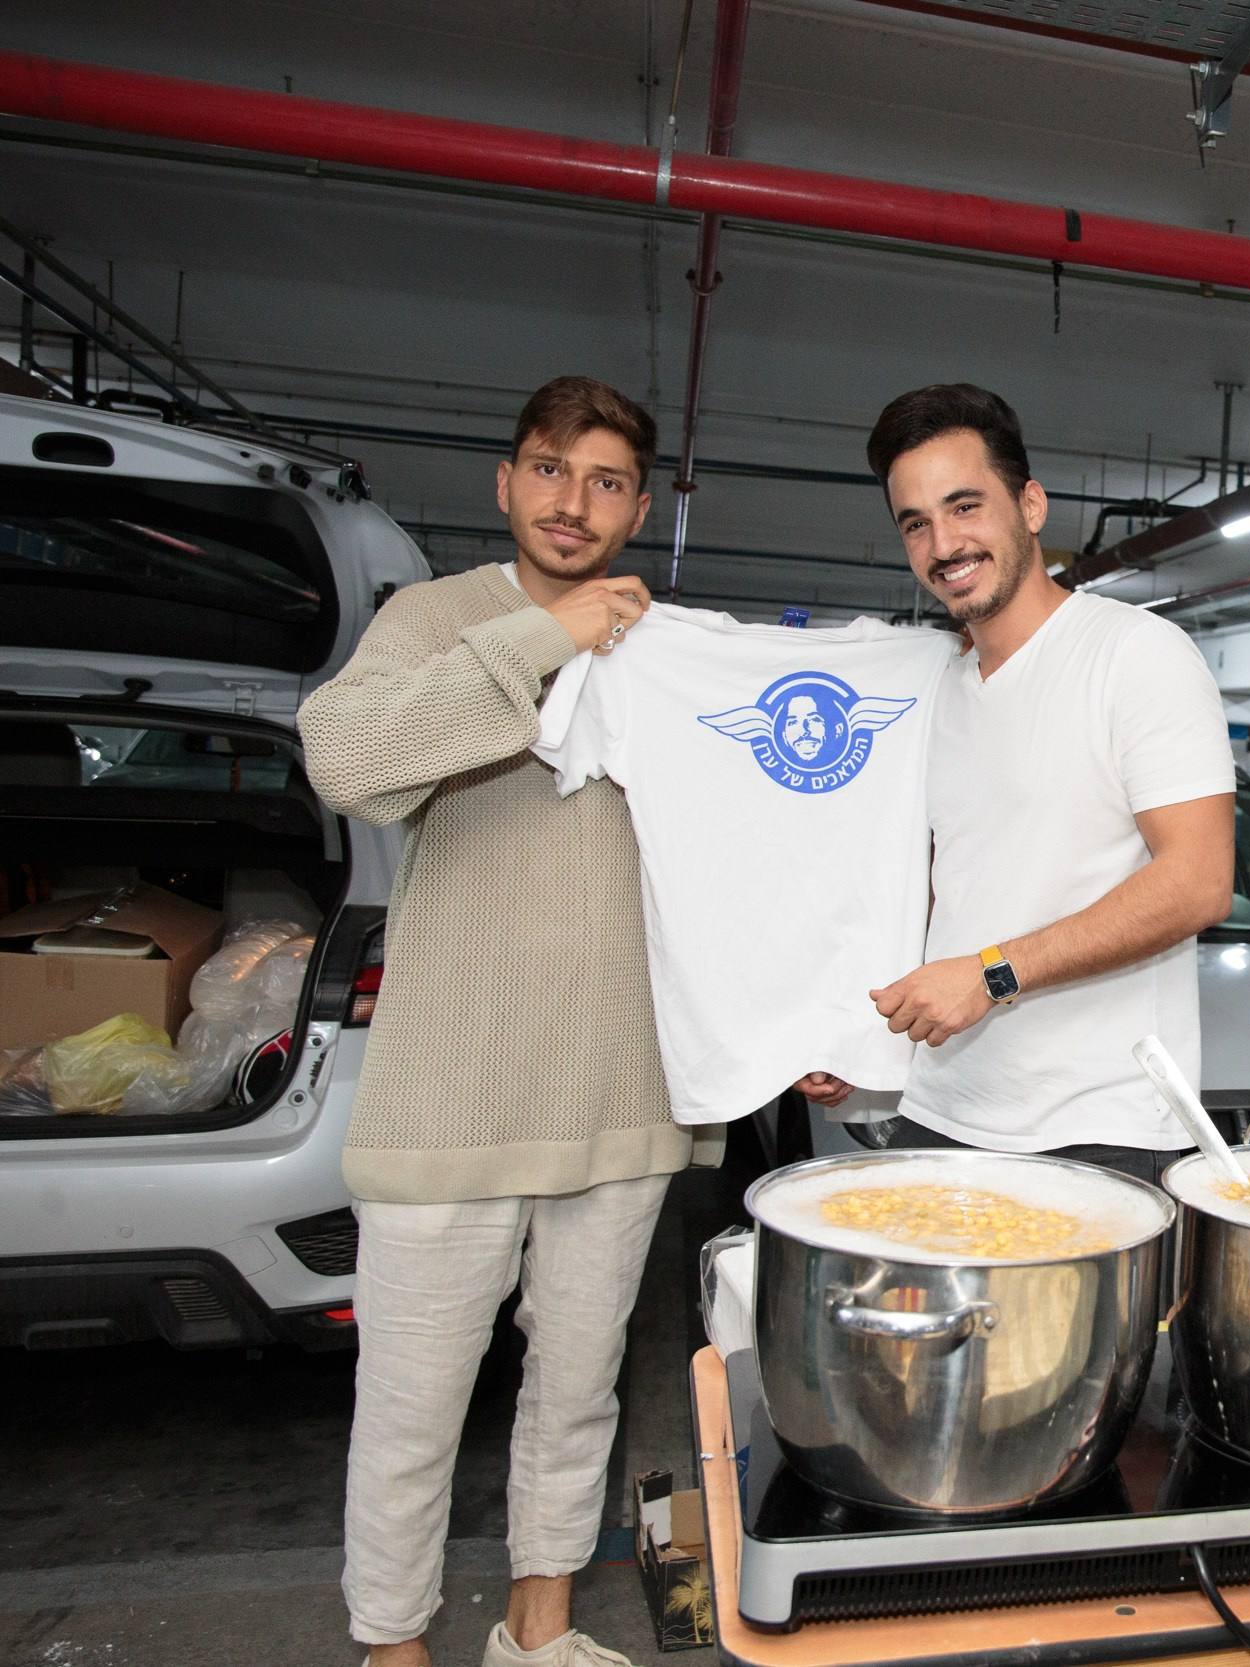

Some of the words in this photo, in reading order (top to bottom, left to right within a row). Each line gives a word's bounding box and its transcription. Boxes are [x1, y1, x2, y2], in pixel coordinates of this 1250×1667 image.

[753, 743, 779, 768] ערן
[811, 738, 869, 790] המלאכים
[780, 766, 804, 787] של
